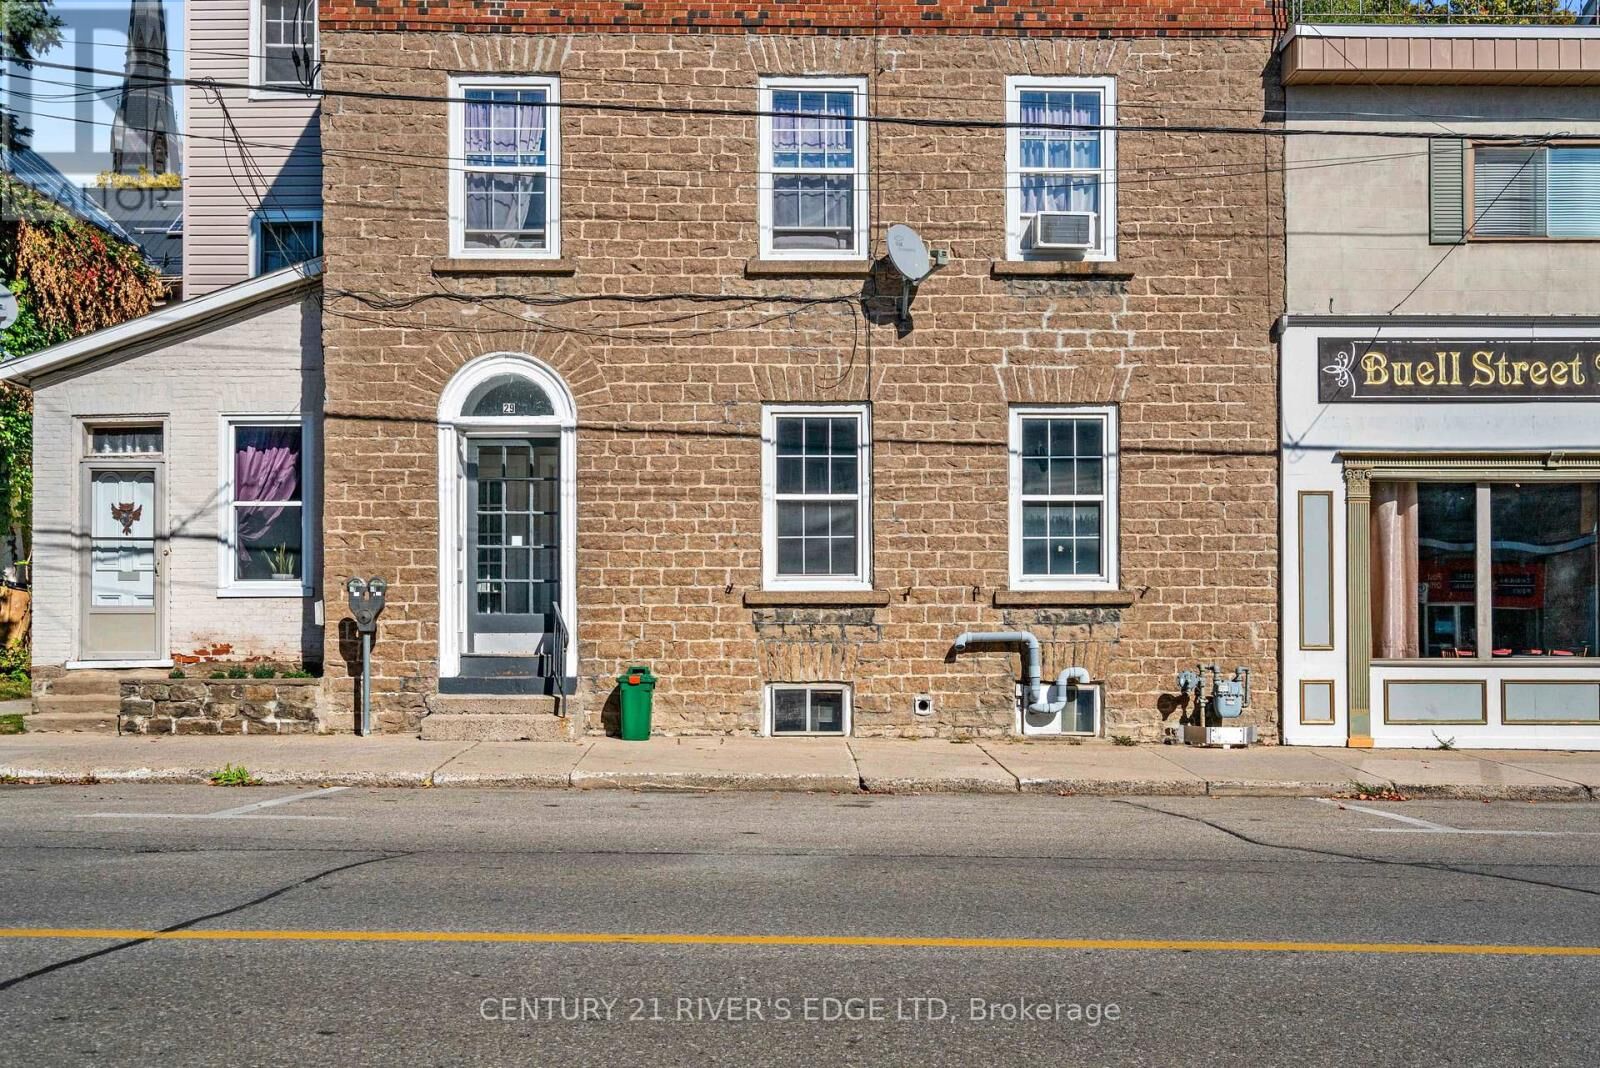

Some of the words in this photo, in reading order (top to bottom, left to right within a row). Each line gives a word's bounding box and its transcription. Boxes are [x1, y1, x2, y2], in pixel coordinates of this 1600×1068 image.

[1360, 351, 1463, 386] Buell
[1469, 351, 1586, 387] Street
[503, 403, 515, 413] 29
